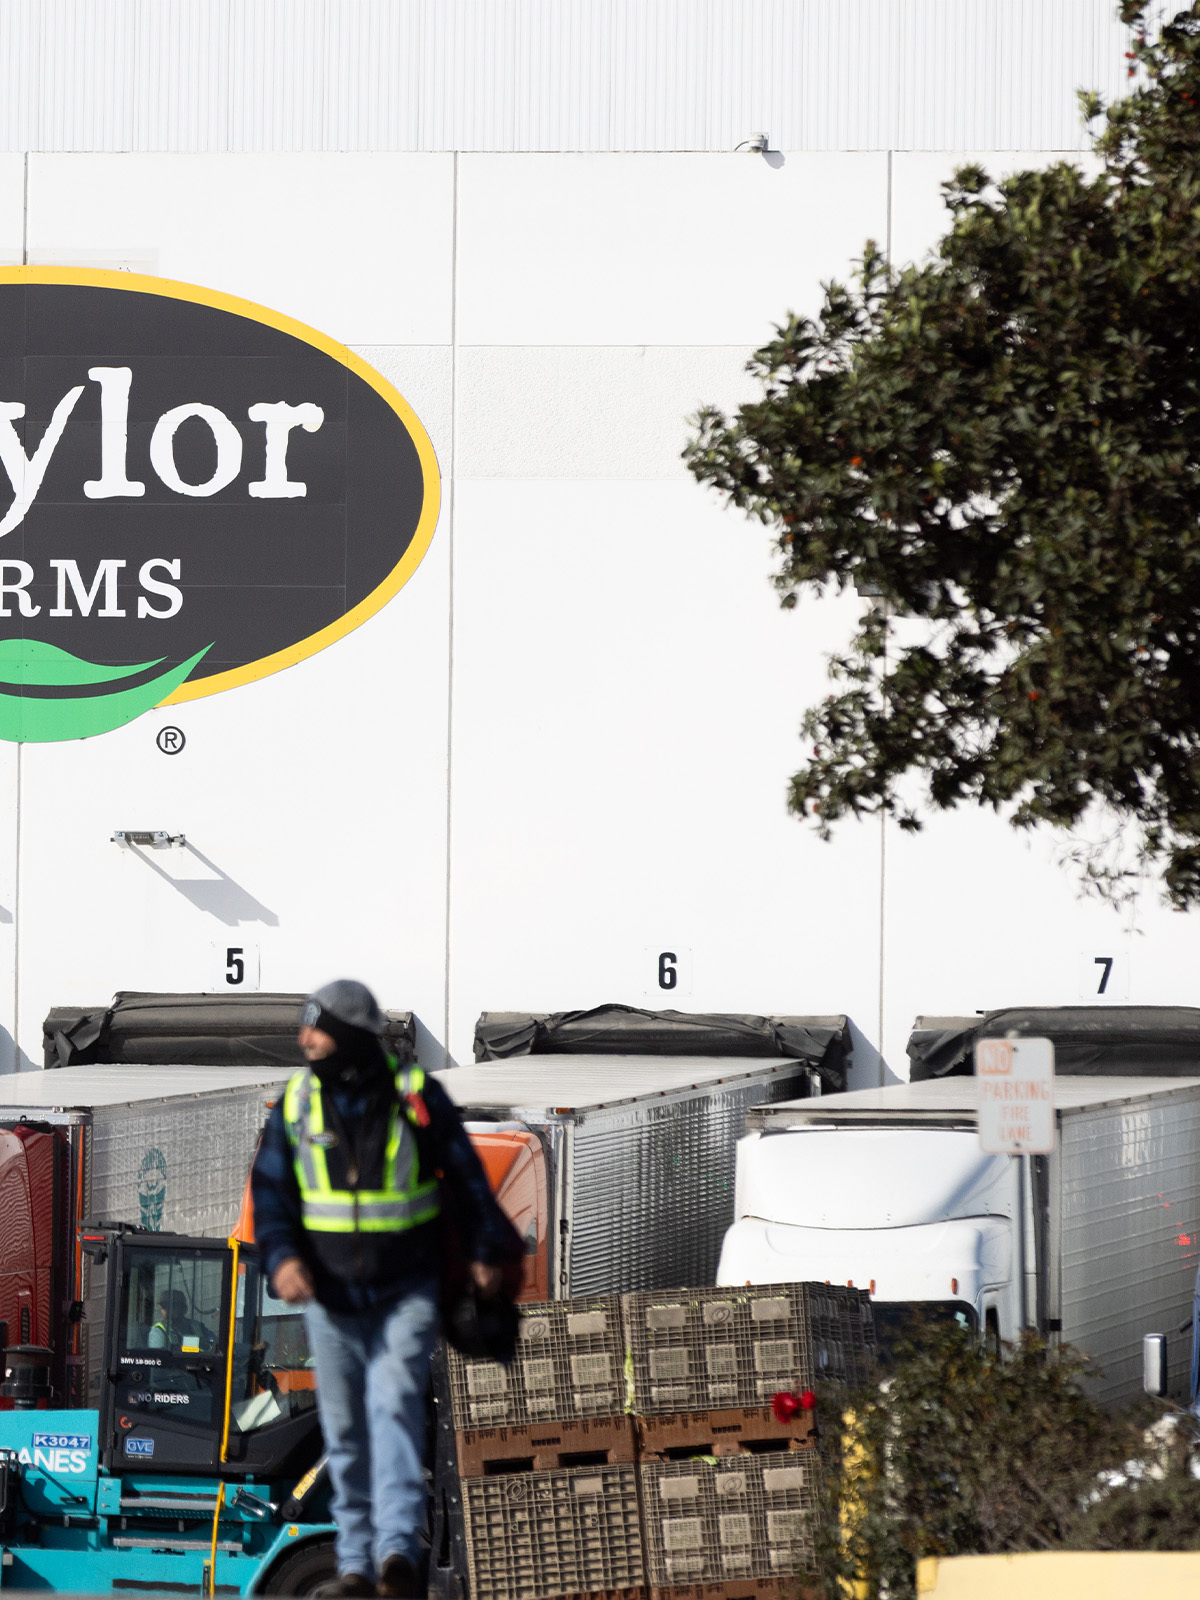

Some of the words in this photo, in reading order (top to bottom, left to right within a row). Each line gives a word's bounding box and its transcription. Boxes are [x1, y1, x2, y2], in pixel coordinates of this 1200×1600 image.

[226, 948, 244, 985] 5
[658, 952, 678, 990] 6
[1094, 957, 1114, 995] 7
[983, 1045, 1009, 1073] NO
[983, 1081, 1051, 1101] PARKING
[1002, 1105, 1032, 1122] FIRE
[999, 1125, 1033, 1142] LANE
[138, 1393, 153, 1403] NO
[154, 1392, 190, 1404] RIDERS
[34, 1435, 90, 1448] K3047
[128, 1441, 153, 1453] GVE
